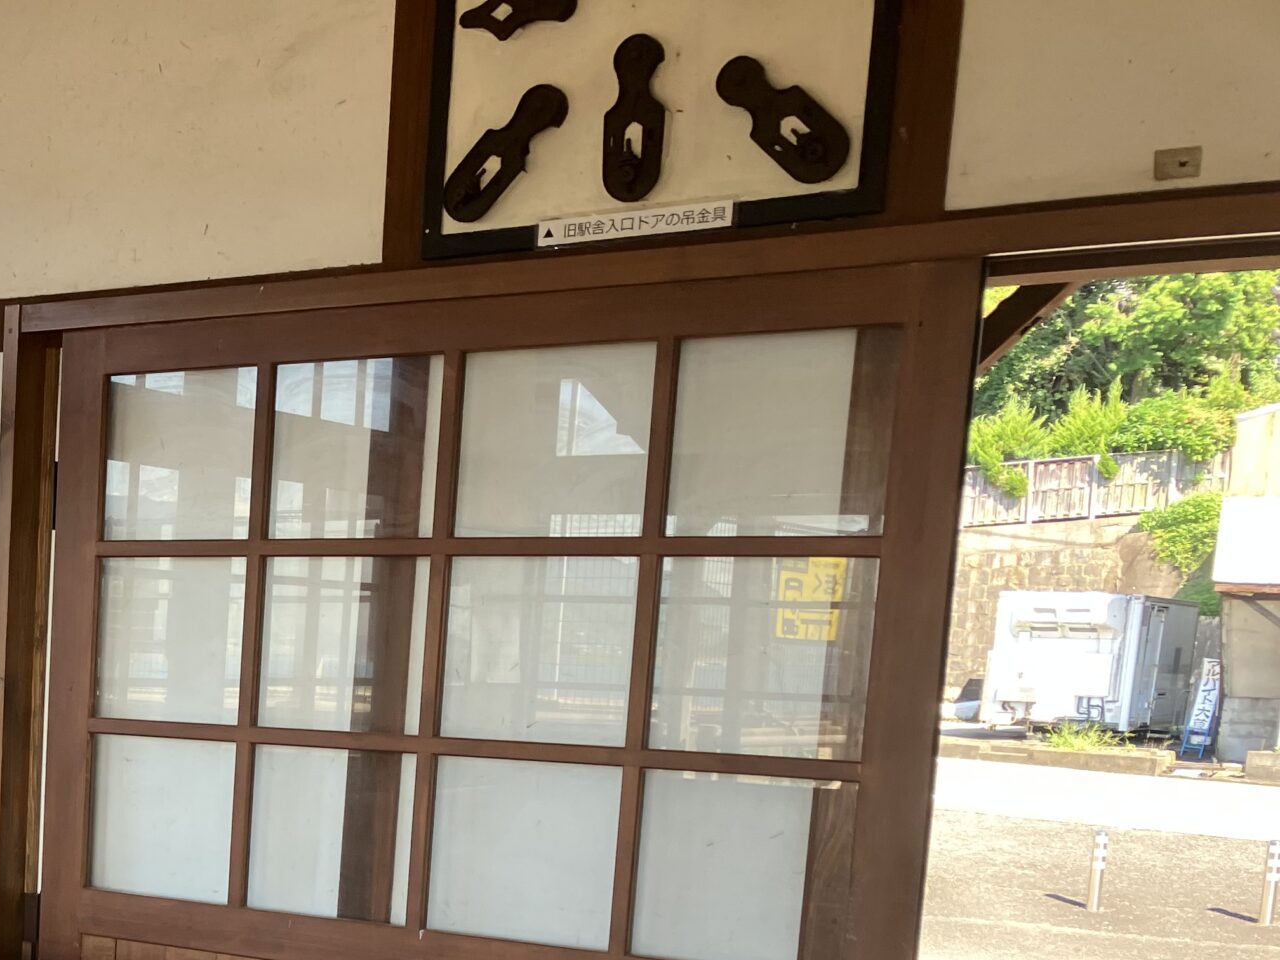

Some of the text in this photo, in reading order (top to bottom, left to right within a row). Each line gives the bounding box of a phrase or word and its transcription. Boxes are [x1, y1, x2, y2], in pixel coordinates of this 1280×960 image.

[563, 206, 726, 239] 旧駅舎入口ドアの吊金具
